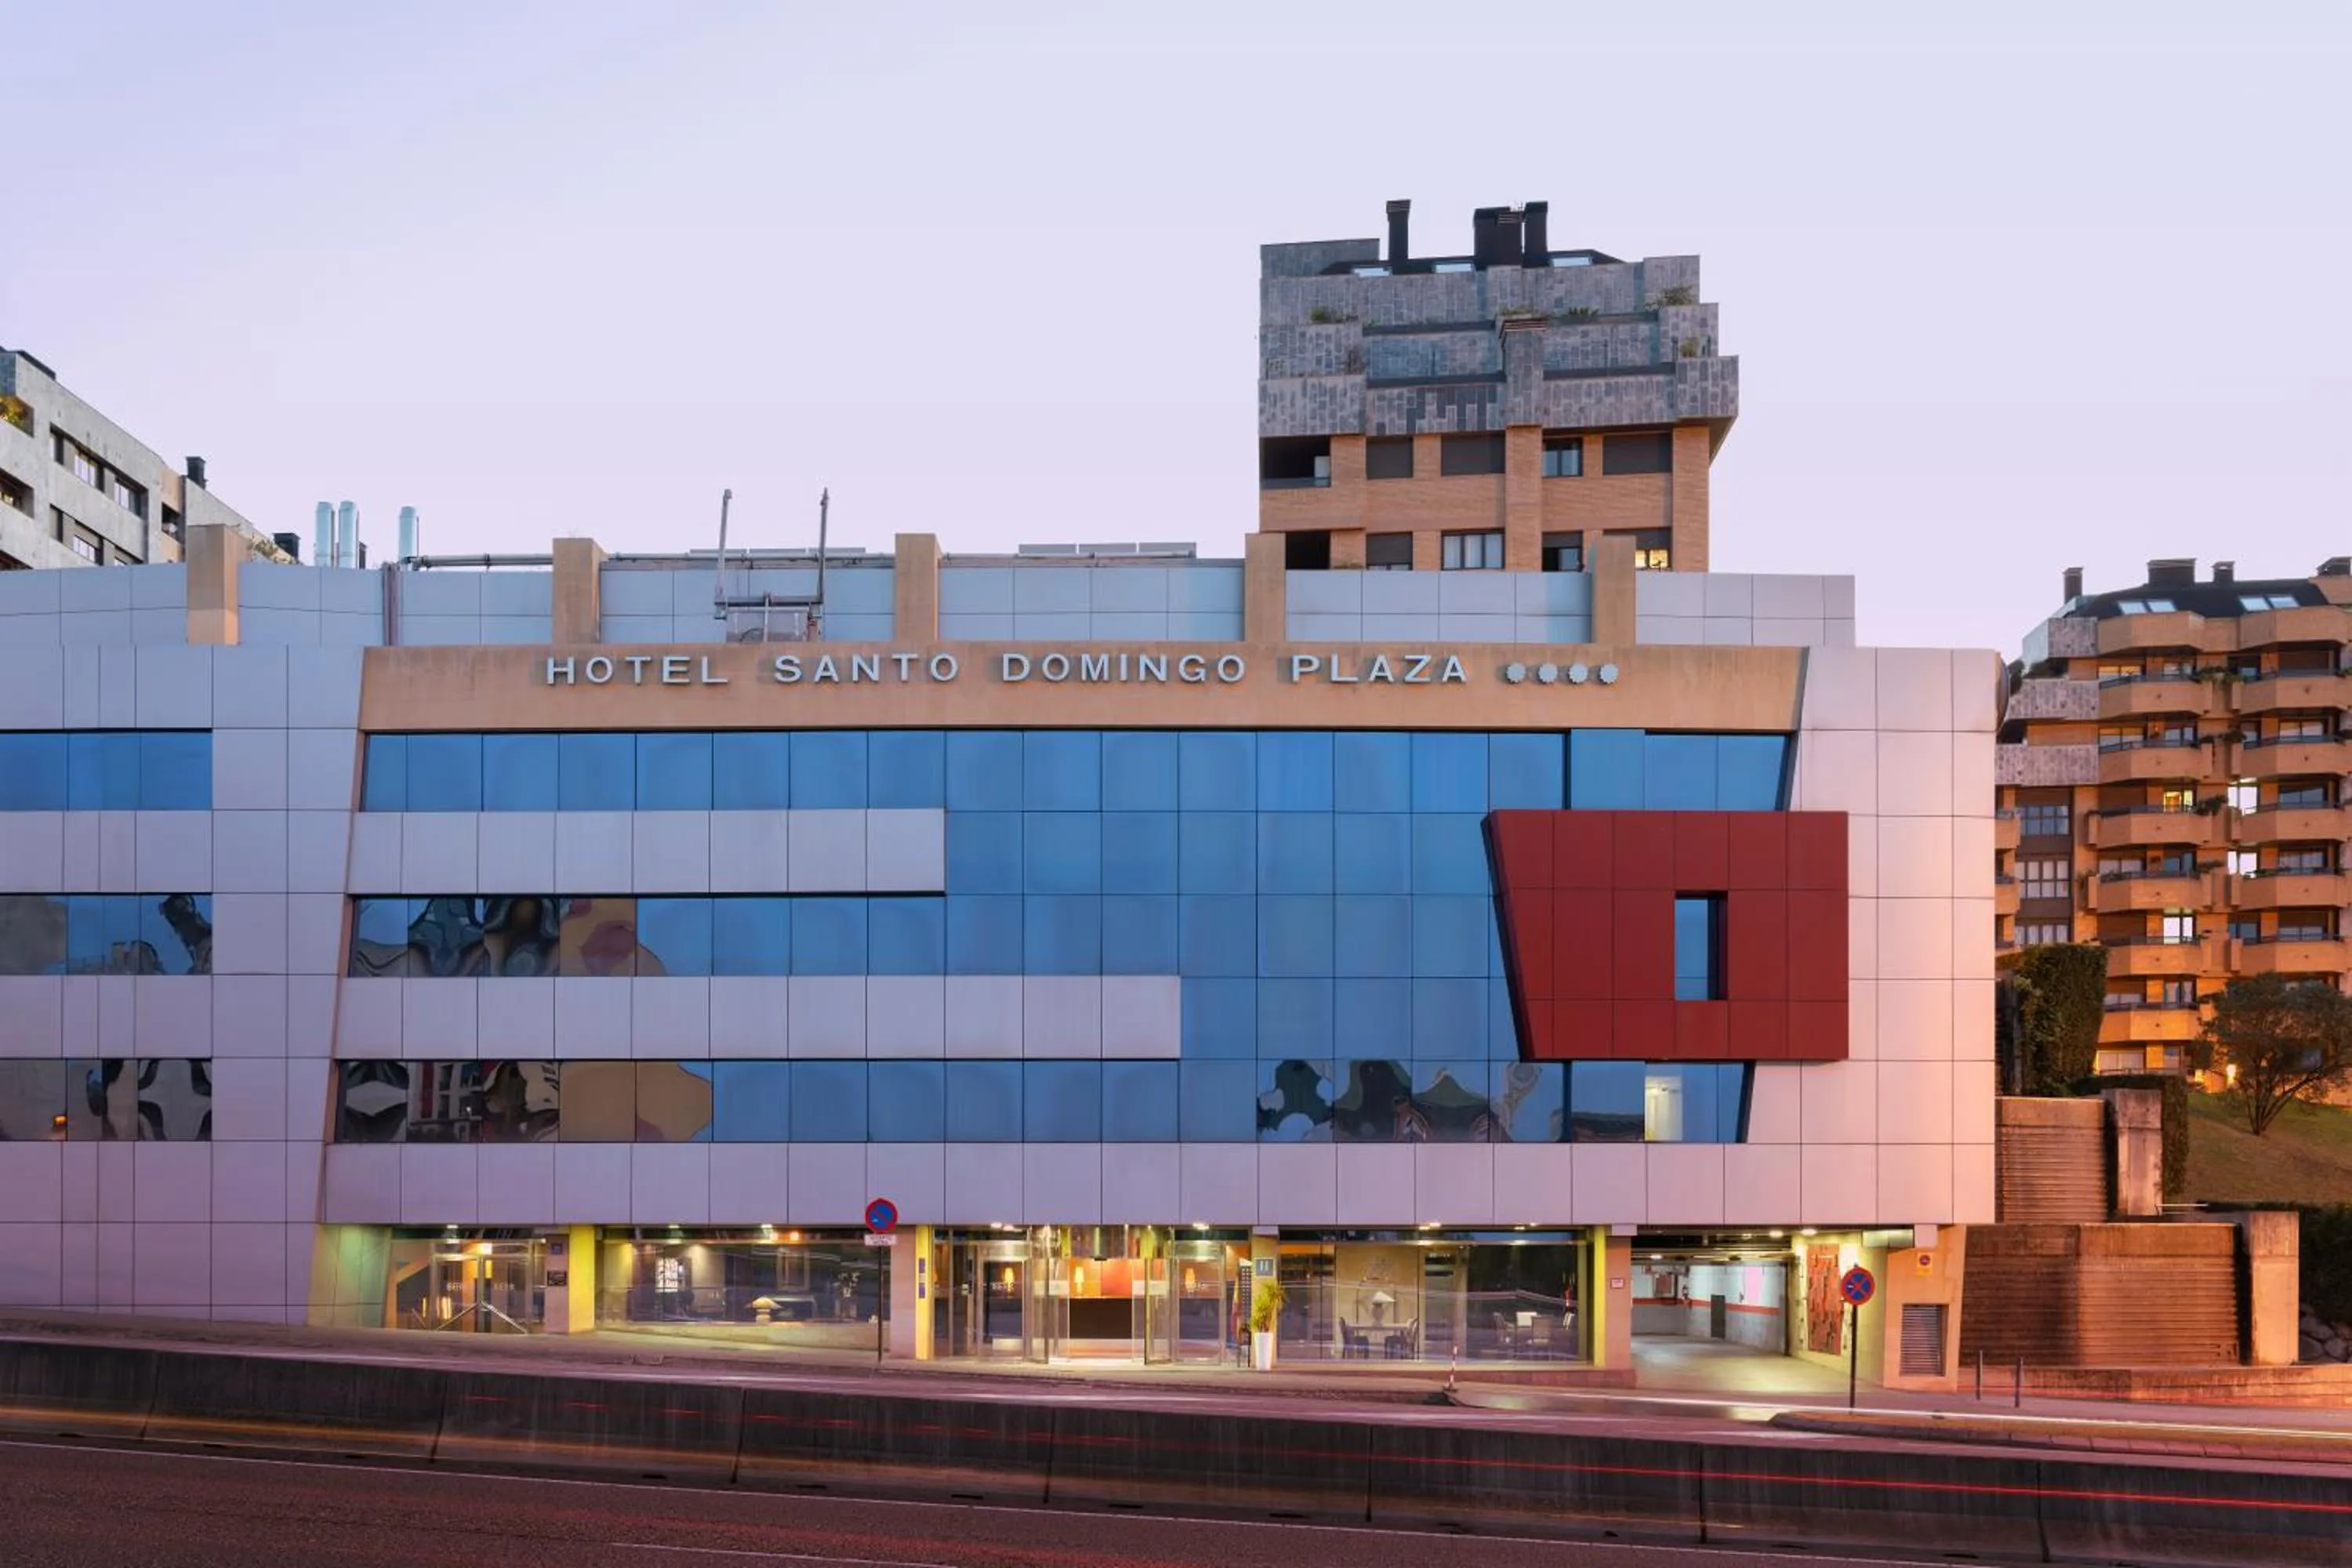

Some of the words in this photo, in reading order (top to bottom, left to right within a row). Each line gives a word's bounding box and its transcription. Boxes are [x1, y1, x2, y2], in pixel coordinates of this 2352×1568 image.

[546, 655, 728, 685] HOTEL
[774, 653, 959, 684] SANTO
[1002, 653, 1247, 684] DOMINGO
[1291, 653, 1468, 684] PLAZA
